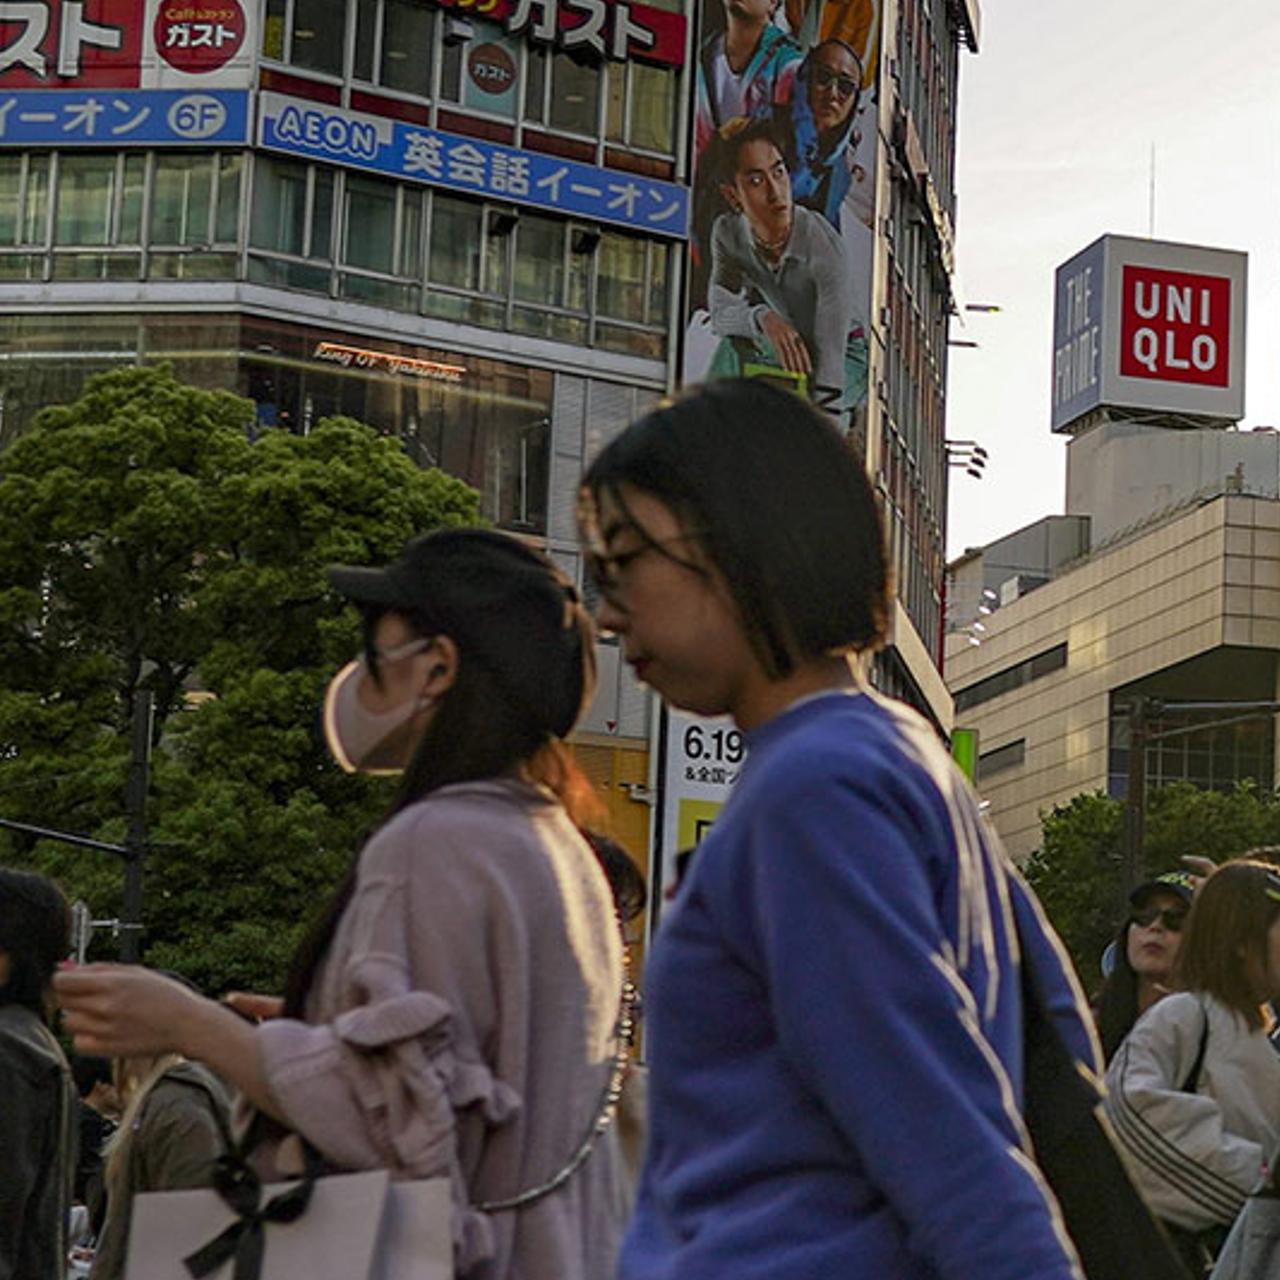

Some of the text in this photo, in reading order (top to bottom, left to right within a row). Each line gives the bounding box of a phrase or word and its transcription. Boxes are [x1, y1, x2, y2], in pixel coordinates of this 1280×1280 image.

[164, 23, 237, 48] ガスト
[275, 107, 380, 160] AEON
[1134, 281, 1210, 327] UNI
[1132, 326, 1218, 373] QLO
[684, 725, 745, 764] 6.19
